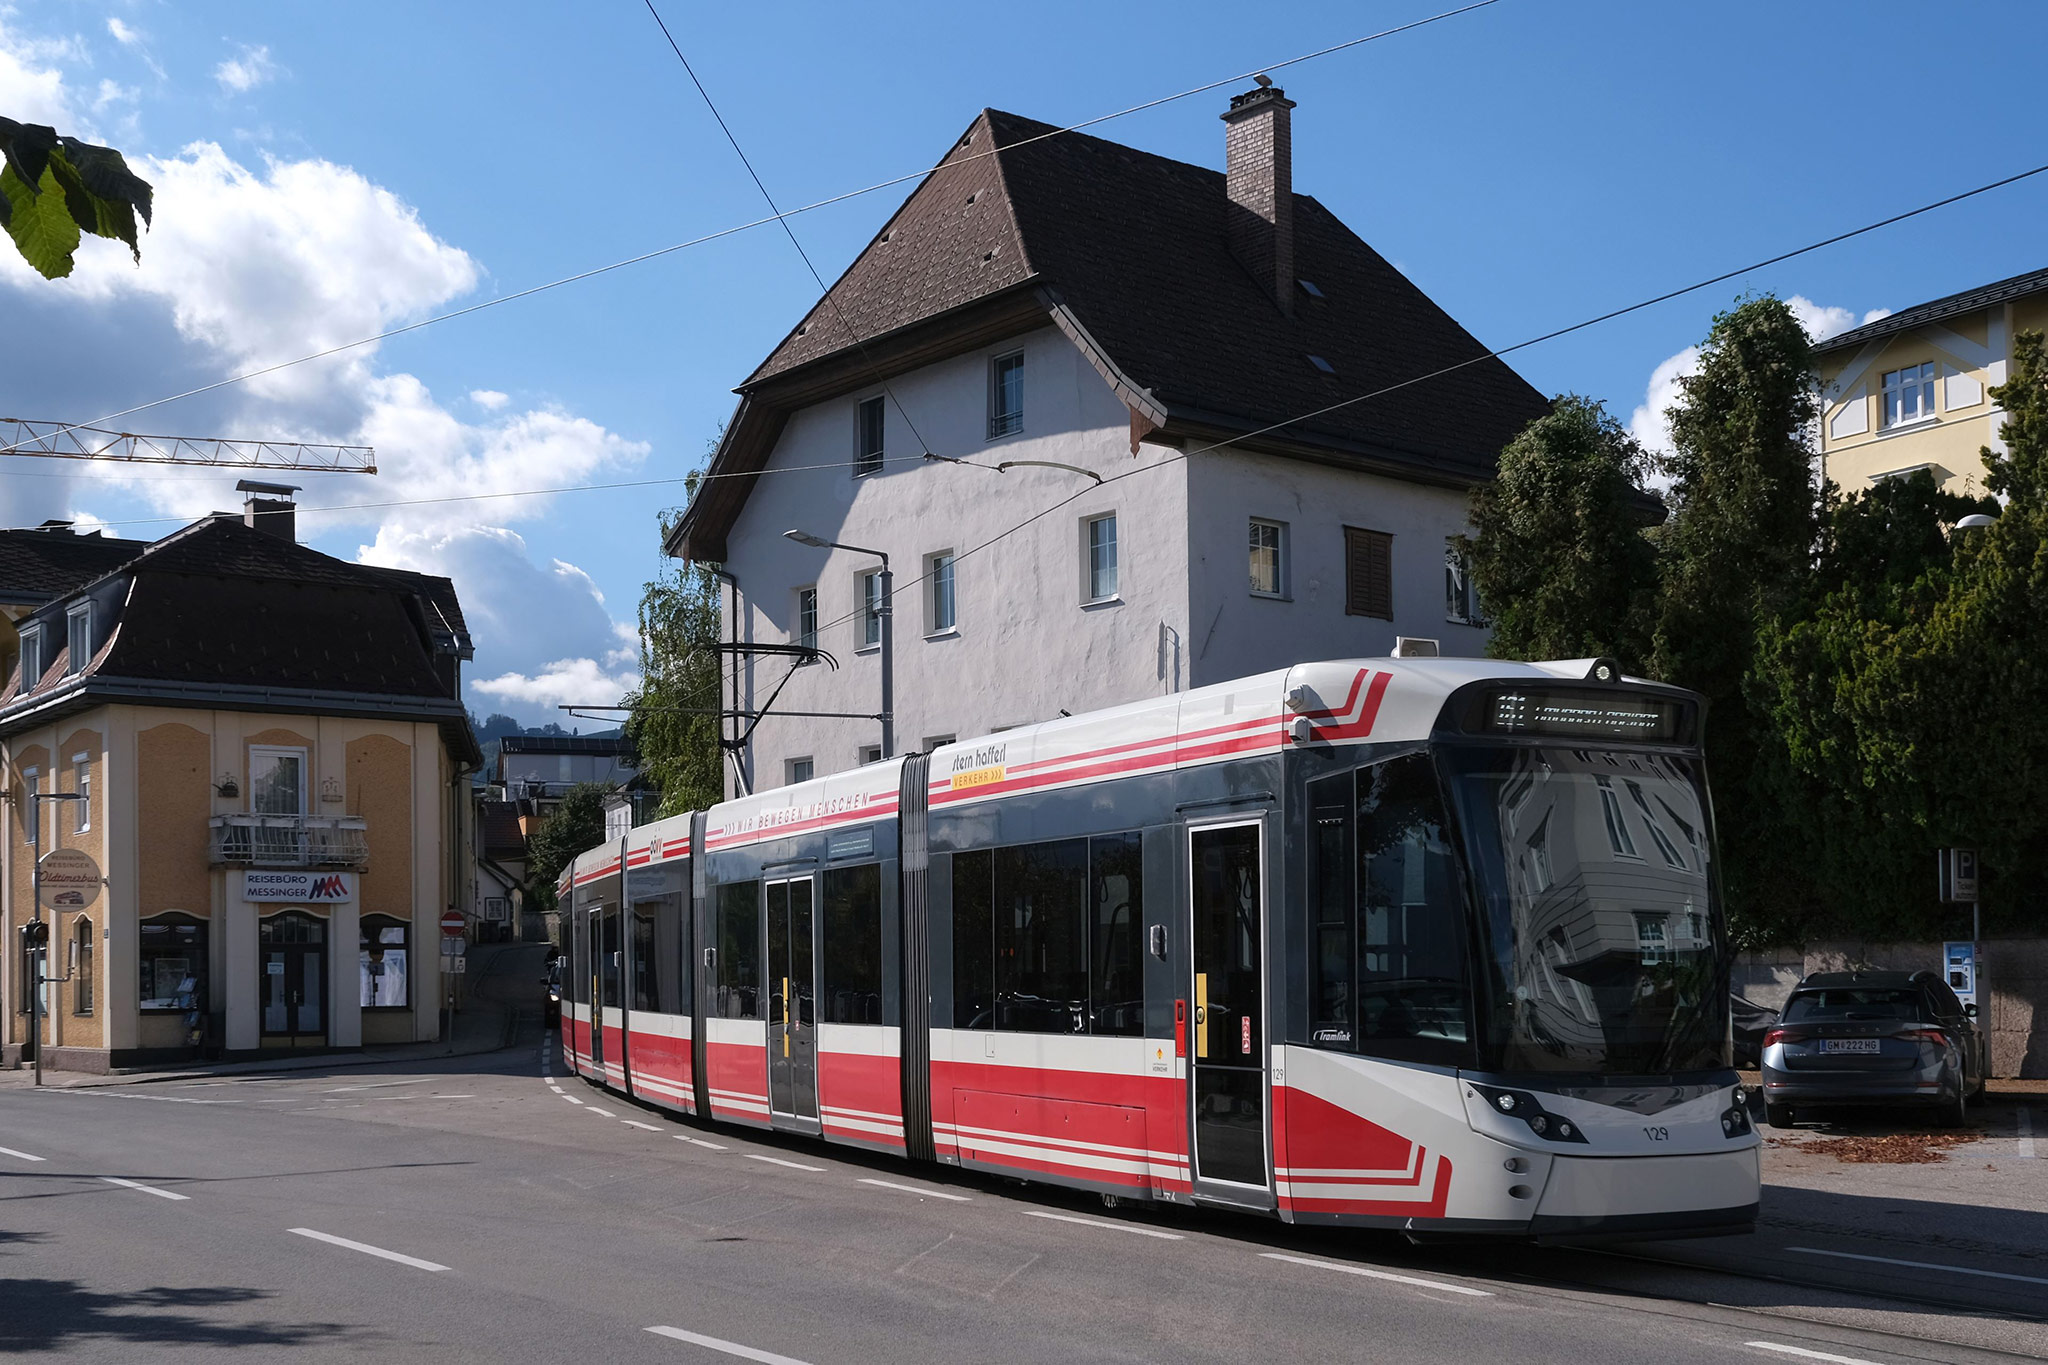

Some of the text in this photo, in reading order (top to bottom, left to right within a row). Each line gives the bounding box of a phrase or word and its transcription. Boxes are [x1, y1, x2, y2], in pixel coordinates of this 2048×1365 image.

[975, 743, 1006, 767] hafferl
[953, 771, 989, 788] VERKEHR
[737, 792, 869, 833] WIR BEWEGEN MENSCHEN
[1960, 852, 1972, 877] P
[40, 870, 98, 882] Oldtimerbus
[248, 875, 307, 884] REISEBÜRO
[247, 888, 307, 897] MESSINGER
[1313, 1029, 1351, 1042] Tramlink
[1273, 1068, 1284, 1080] 129
[1643, 1127, 1669, 1141] 129
